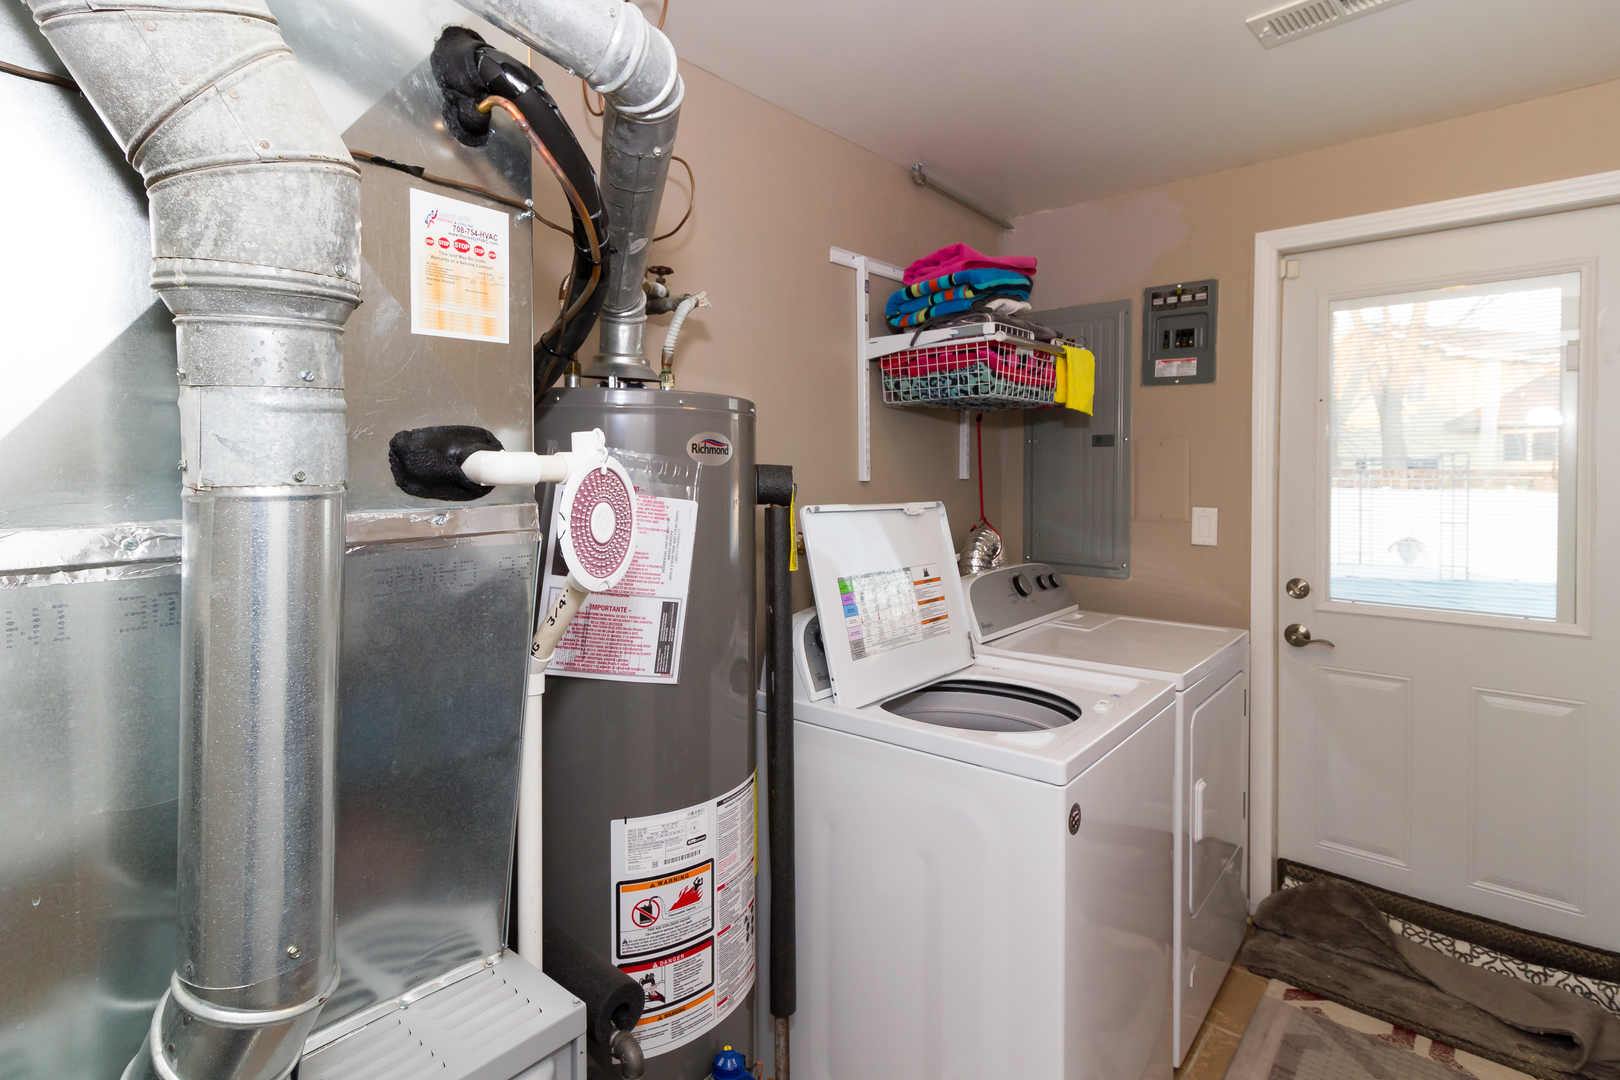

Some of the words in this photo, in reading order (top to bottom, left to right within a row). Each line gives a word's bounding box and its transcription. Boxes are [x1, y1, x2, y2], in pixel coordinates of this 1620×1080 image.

[453, 225, 498, 241] 708-754-HVAC
[430, 255, 450, 263] Warranty
[692, 443, 728, 455] Richmond
[590, 604, 627, 613] IMPORTANTE
[658, 873, 689, 886] WARNING
[660, 954, 685, 966] DANGER
